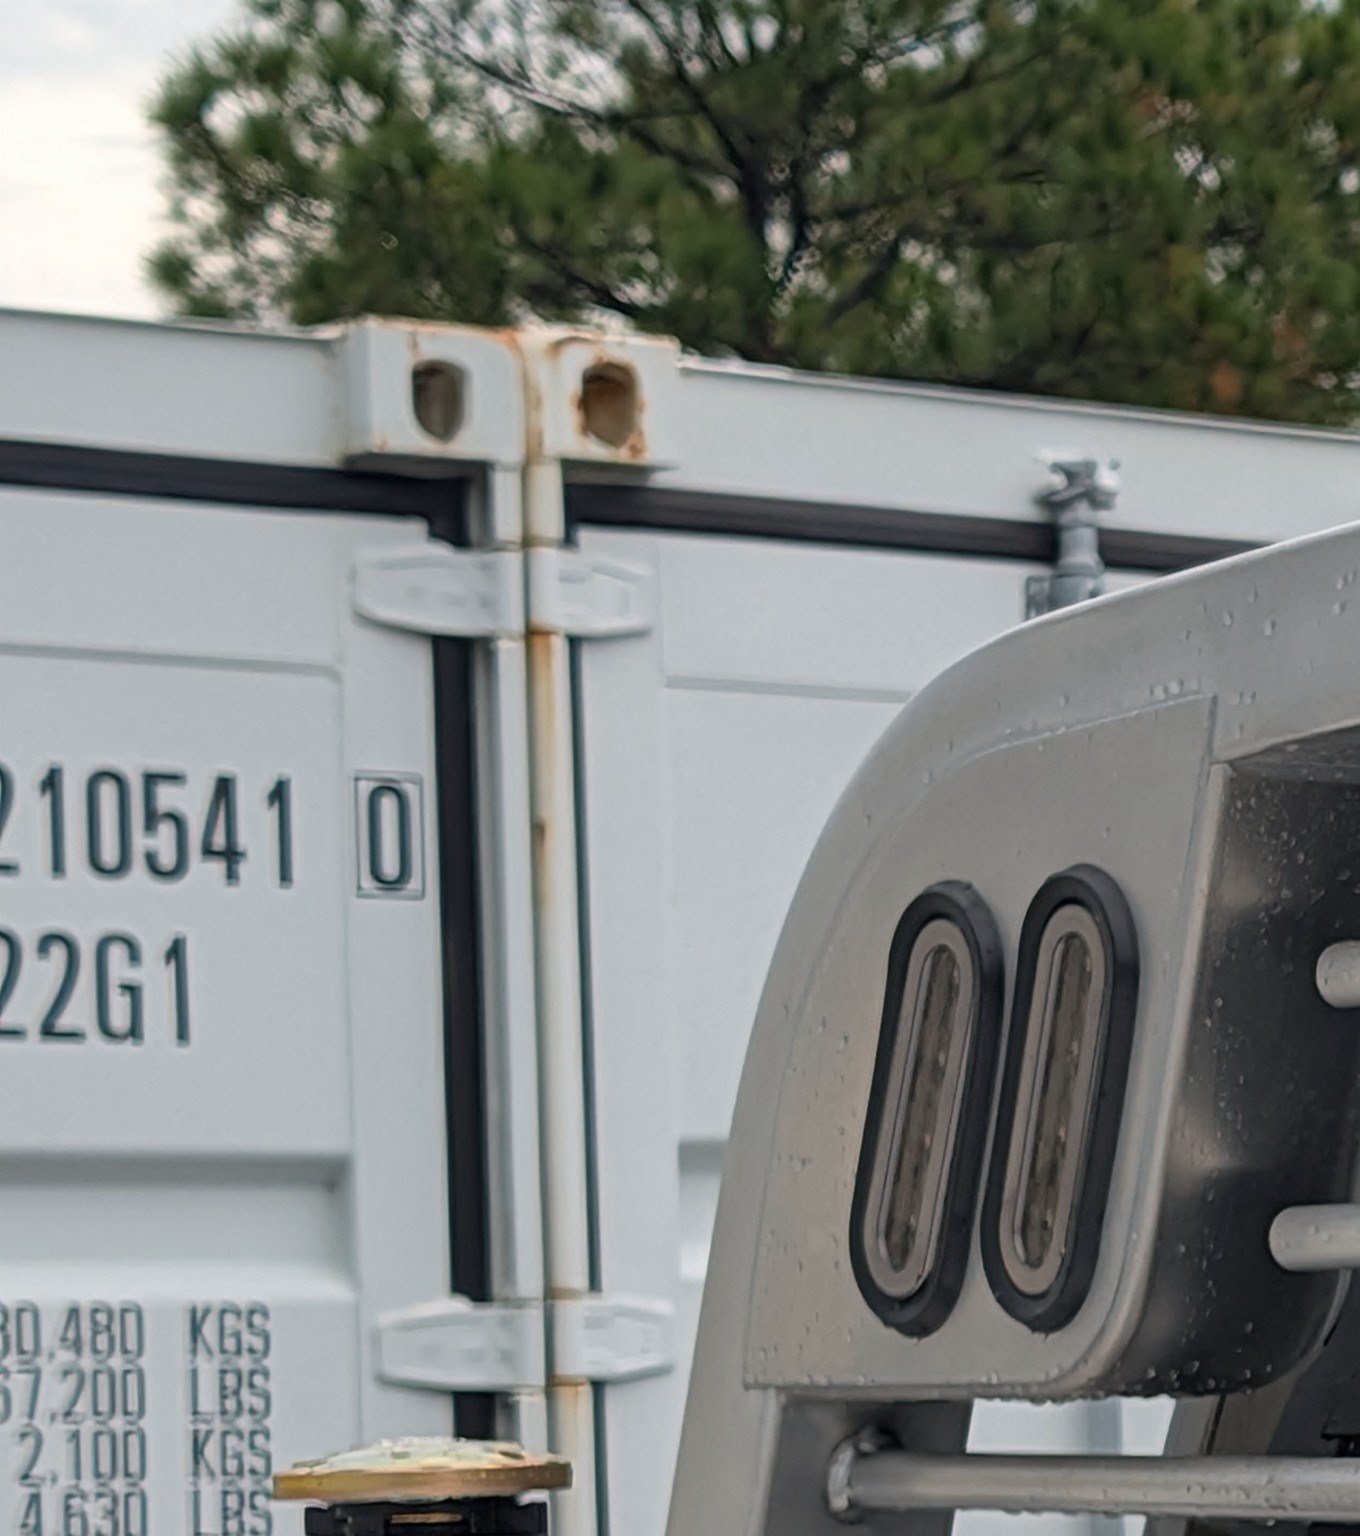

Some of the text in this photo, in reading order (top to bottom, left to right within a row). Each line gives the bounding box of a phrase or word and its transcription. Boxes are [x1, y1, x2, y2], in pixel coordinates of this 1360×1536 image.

[0, 927, 190, 1048] 22G1
[189, 1301, 271, 1363] KGS
[189, 1364, 272, 1426] LBS
[17, 1424, 272, 1488] 2,100 KGS
